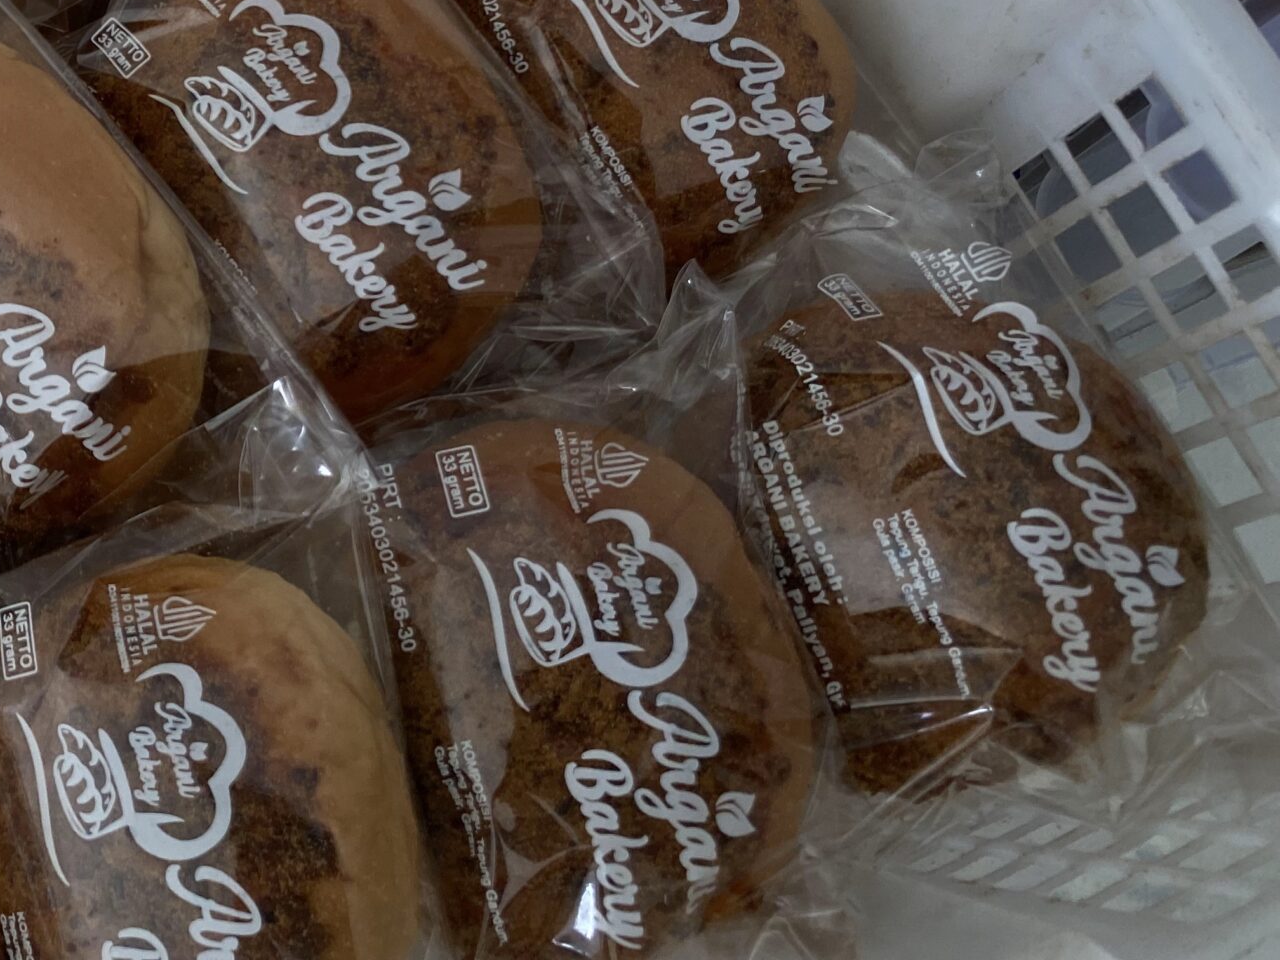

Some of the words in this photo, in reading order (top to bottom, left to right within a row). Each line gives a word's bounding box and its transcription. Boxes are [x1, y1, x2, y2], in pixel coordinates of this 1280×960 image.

[97, 33, 113, 49] 33
[109, 47, 133, 72] gram
[106, 23, 145, 63] NETTO
[242, 47, 293, 102] Bakery
[252, 23, 318, 85] Argani
[709, 37, 840, 194] Argani
[590, 125, 633, 187] KOMPOSISI
[680, 96, 764, 235] Bakery
[320, 122, 488, 292] Argani
[294, 191, 418, 333] Bakery
[838, 277, 876, 313] NETTO
[921, 248, 970, 311] INDONESIA
[938, 248, 979, 301] HALAL
[376, 463, 402, 509] PIRT
[441, 455, 456, 473] 33
[443, 476, 465, 510] gram
[457, 451, 483, 507] NETTO
[566, 431, 590, 510] INDONESIA
[579, 439, 601, 499] HALAL
[762, 419, 824, 536] Diproduksi
[814, 539, 844, 592] oleh
[778, 514, 830, 606] BAKERY
[872, 518, 891, 549] Gula
[901, 583, 925, 624] Garam
[887, 513, 912, 558] Tepung
[926, 601, 952, 645] Tepung
[901, 508, 942, 583] KOMPOSISI
[2, 612, 14, 632] 33
[586, 561, 620, 639] Bakery
[606, 543, 656, 631] Argani
[1007, 508, 1100, 693] Bakery
[1, 635, 17, 672] gram
[14, 608, 33, 668] NETTO
[120, 587, 143, 666] INDONESIA
[134, 594, 159, 656] HALAL
[129, 725, 161, 808] Bakery
[155, 701, 209, 800] Argani
[461, 740, 492, 821] KOMPOSISI
[564, 748, 649, 951] Bakery
